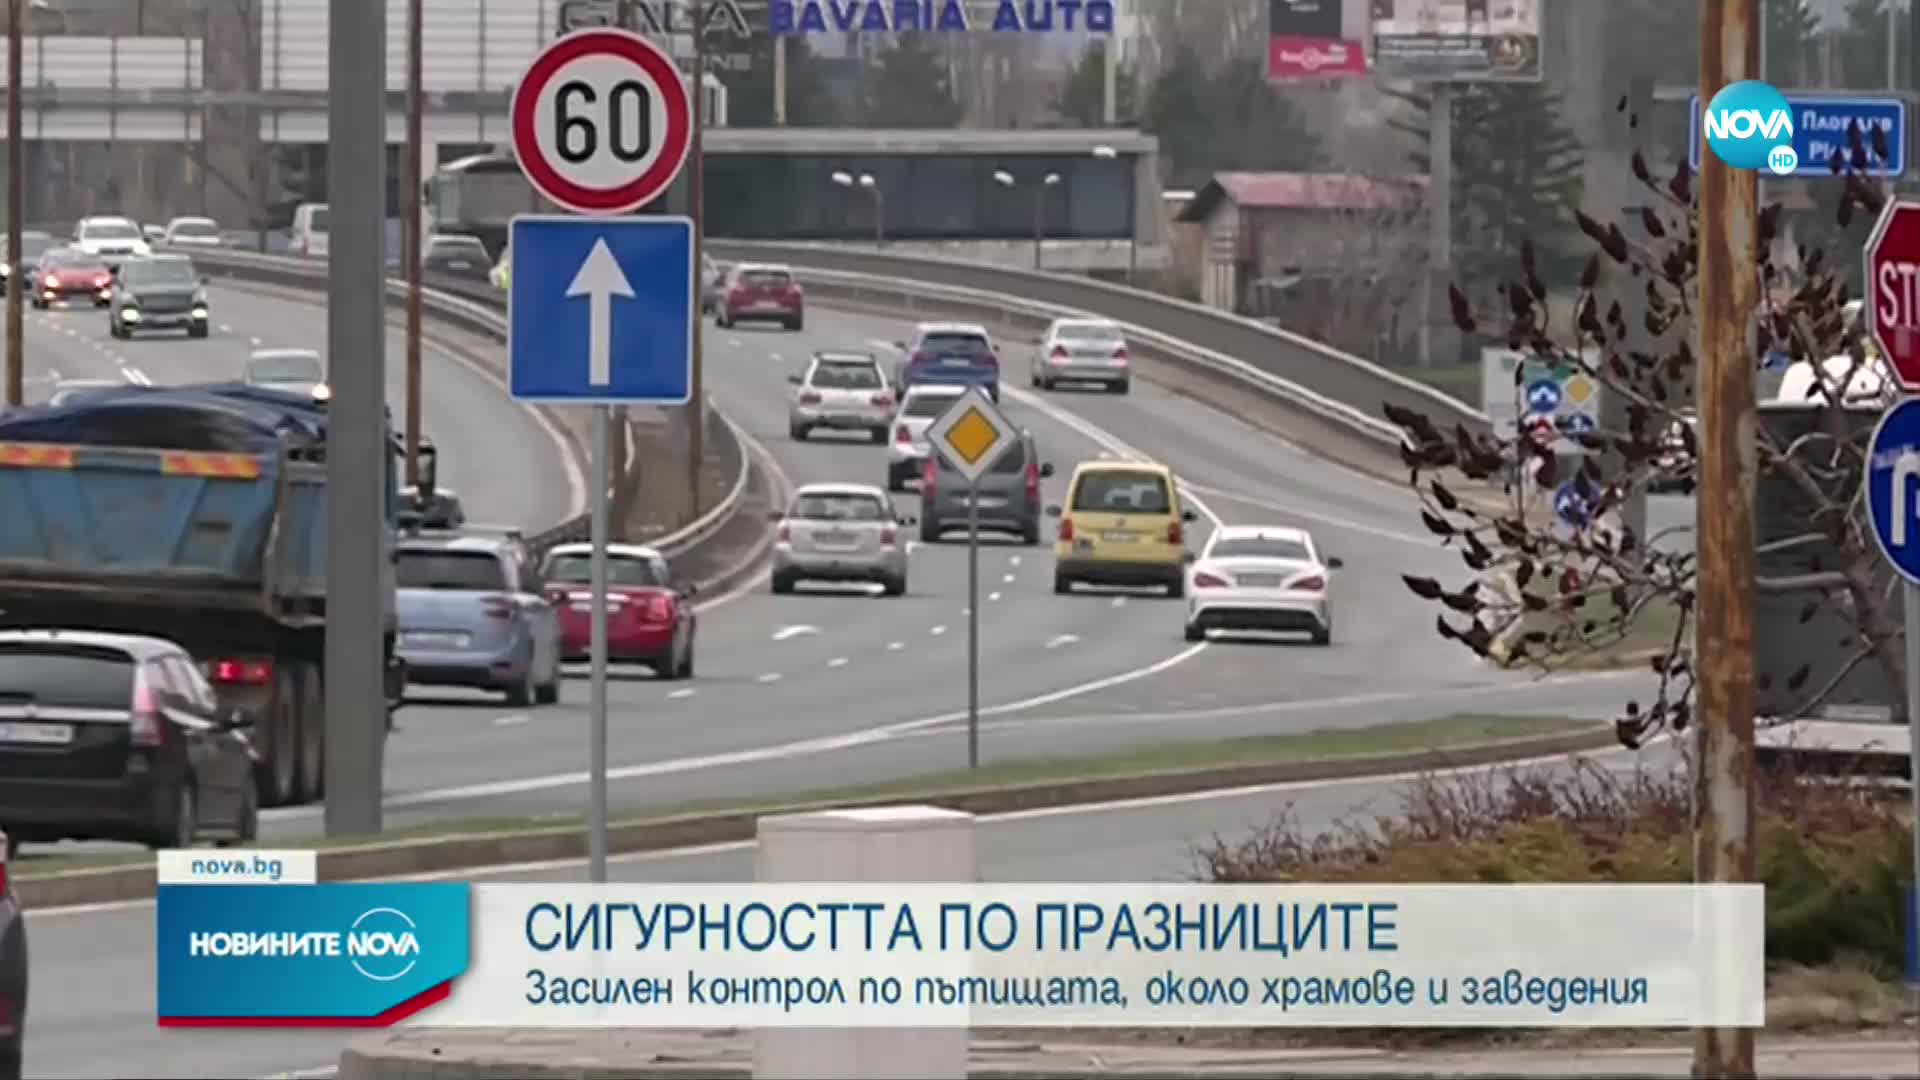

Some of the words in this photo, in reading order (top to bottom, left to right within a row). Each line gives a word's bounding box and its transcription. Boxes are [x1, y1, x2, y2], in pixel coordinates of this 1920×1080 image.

[769, 0, 969, 33] BAVARIA
[993, 0, 1114, 32] AUTO
[555, 80, 651, 164] 60
[1879, 259, 1920, 329] ST
